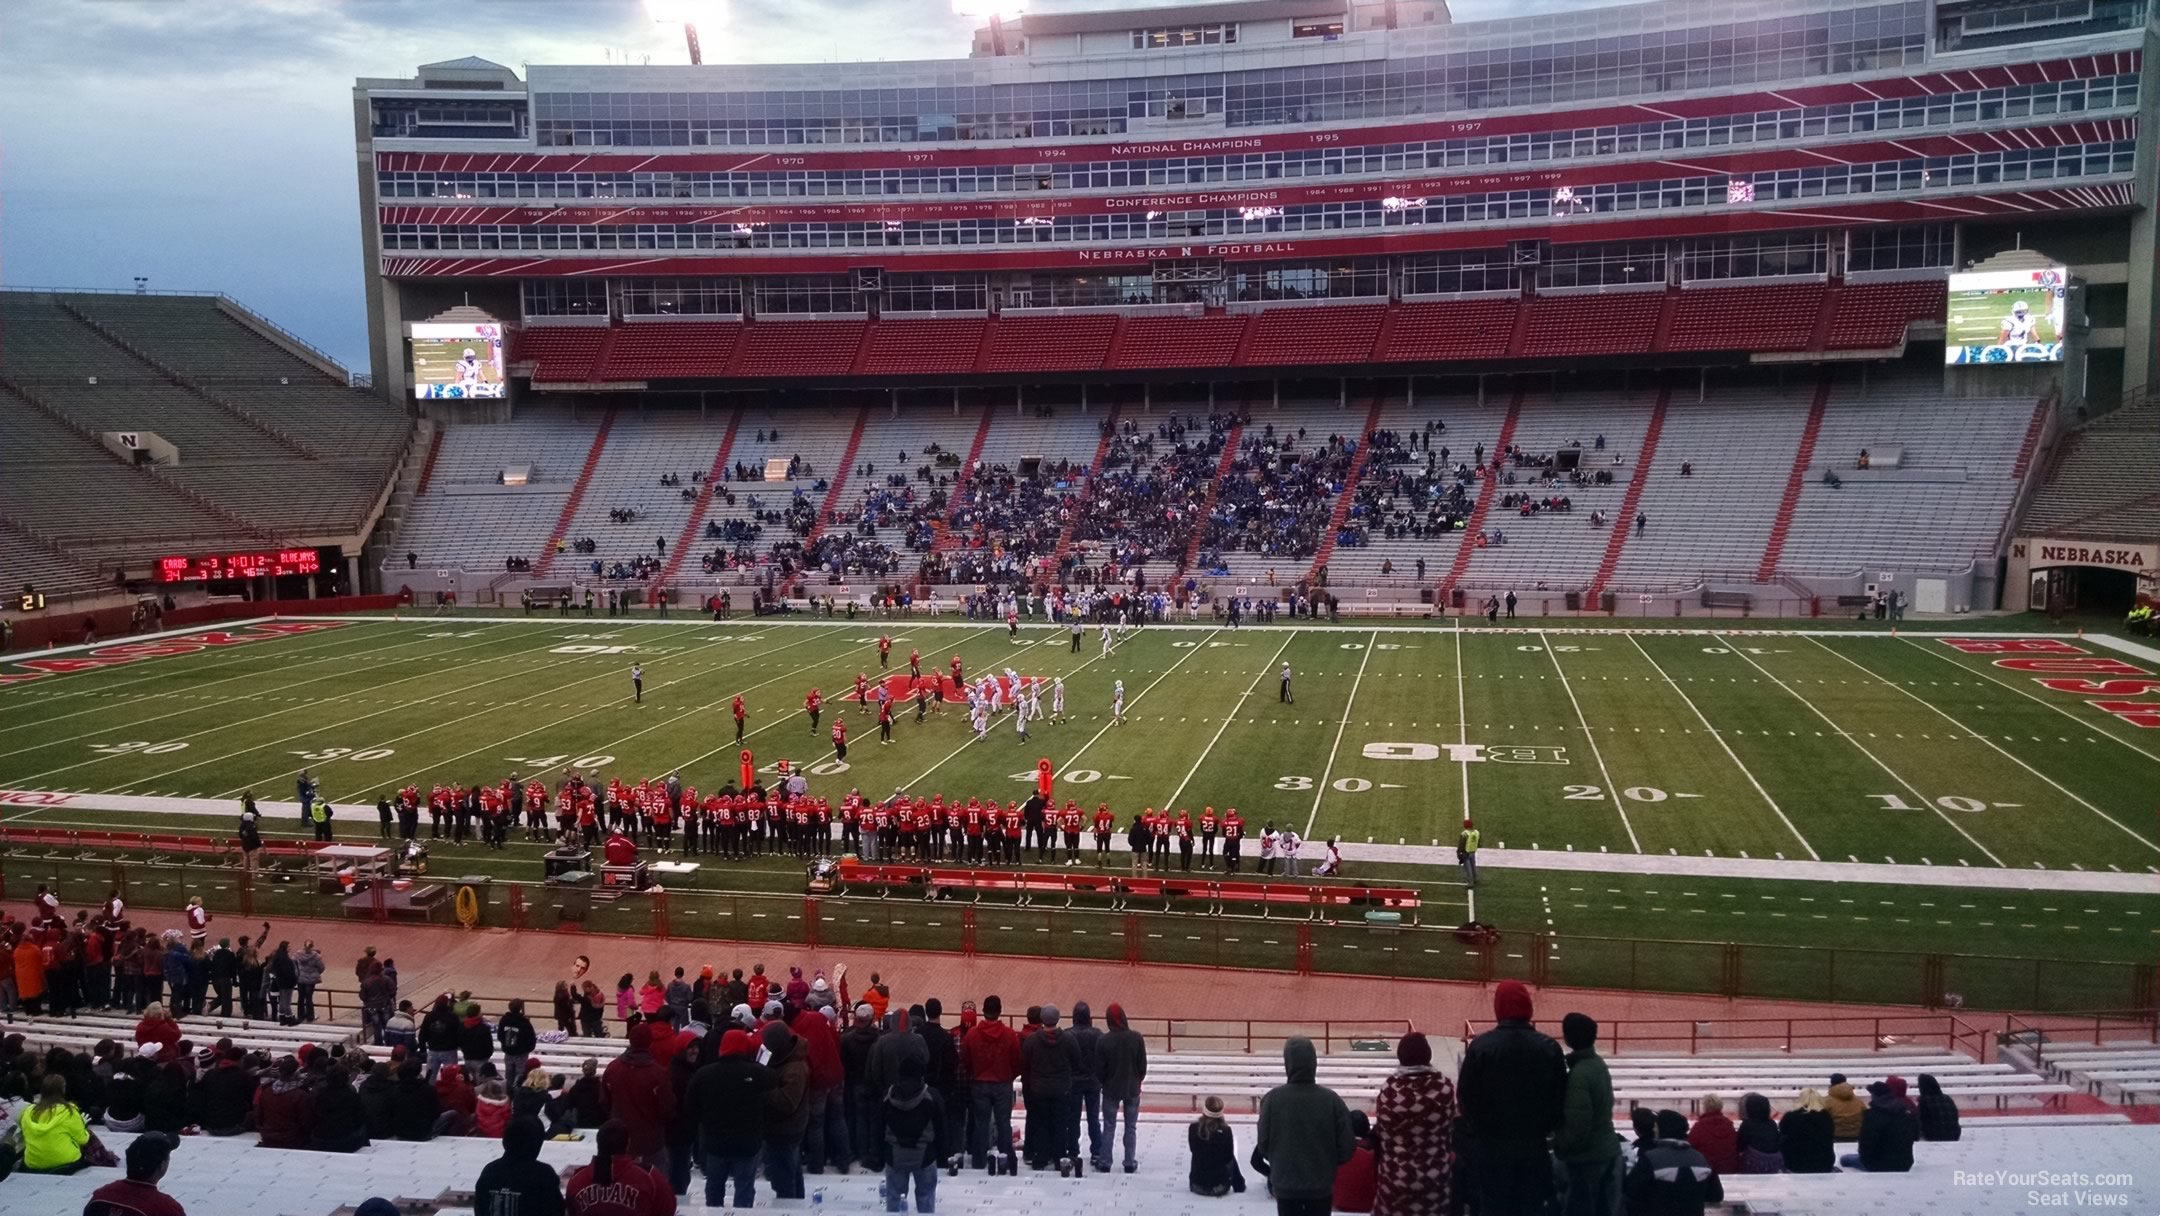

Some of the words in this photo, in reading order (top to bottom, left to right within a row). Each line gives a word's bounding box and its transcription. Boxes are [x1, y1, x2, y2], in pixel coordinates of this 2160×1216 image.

[907, 153, 934, 162] 1971
[1038, 149, 1066, 158] 1994
[1309, 134, 1340, 142] 1995
[1450, 122, 1482, 132] 1997
[1079, 248, 1168, 260] NEBRASKA
[1182, 246, 1192, 256] N
[1208, 243, 1295, 254] FOOTBALL
[121, 434, 136, 447] N
[258, 556, 265, 566] 2
[280, 551, 316, 564] BLUEJAYS
[2013, 544, 2026, 558] N
[2041, 546, 2144, 566] NEBRASKA
[211, 558, 218, 568] 3
[299, 563, 310, 573] 14
[166, 570, 181, 582] 34
[200, 570, 208, 580] 3
[227, 569, 234, 578] 2
[244, 568, 256, 578] 46
[275, 566, 282, 576] 3
[22, 594, 45, 610] 21
[302, 747, 396, 760] 30
[525, 755, 616, 768] 40
[780, 760, 788, 772] 3
[1274, 775, 1372, 793] 30
[1562, 785, 1668, 802] 20
[1866, 794, 1987, 813] 10
[968, 812, 978, 824] 11
[1226, 826, 1238, 837] 21
[575, 1183, 640, 1210] YUTAN
